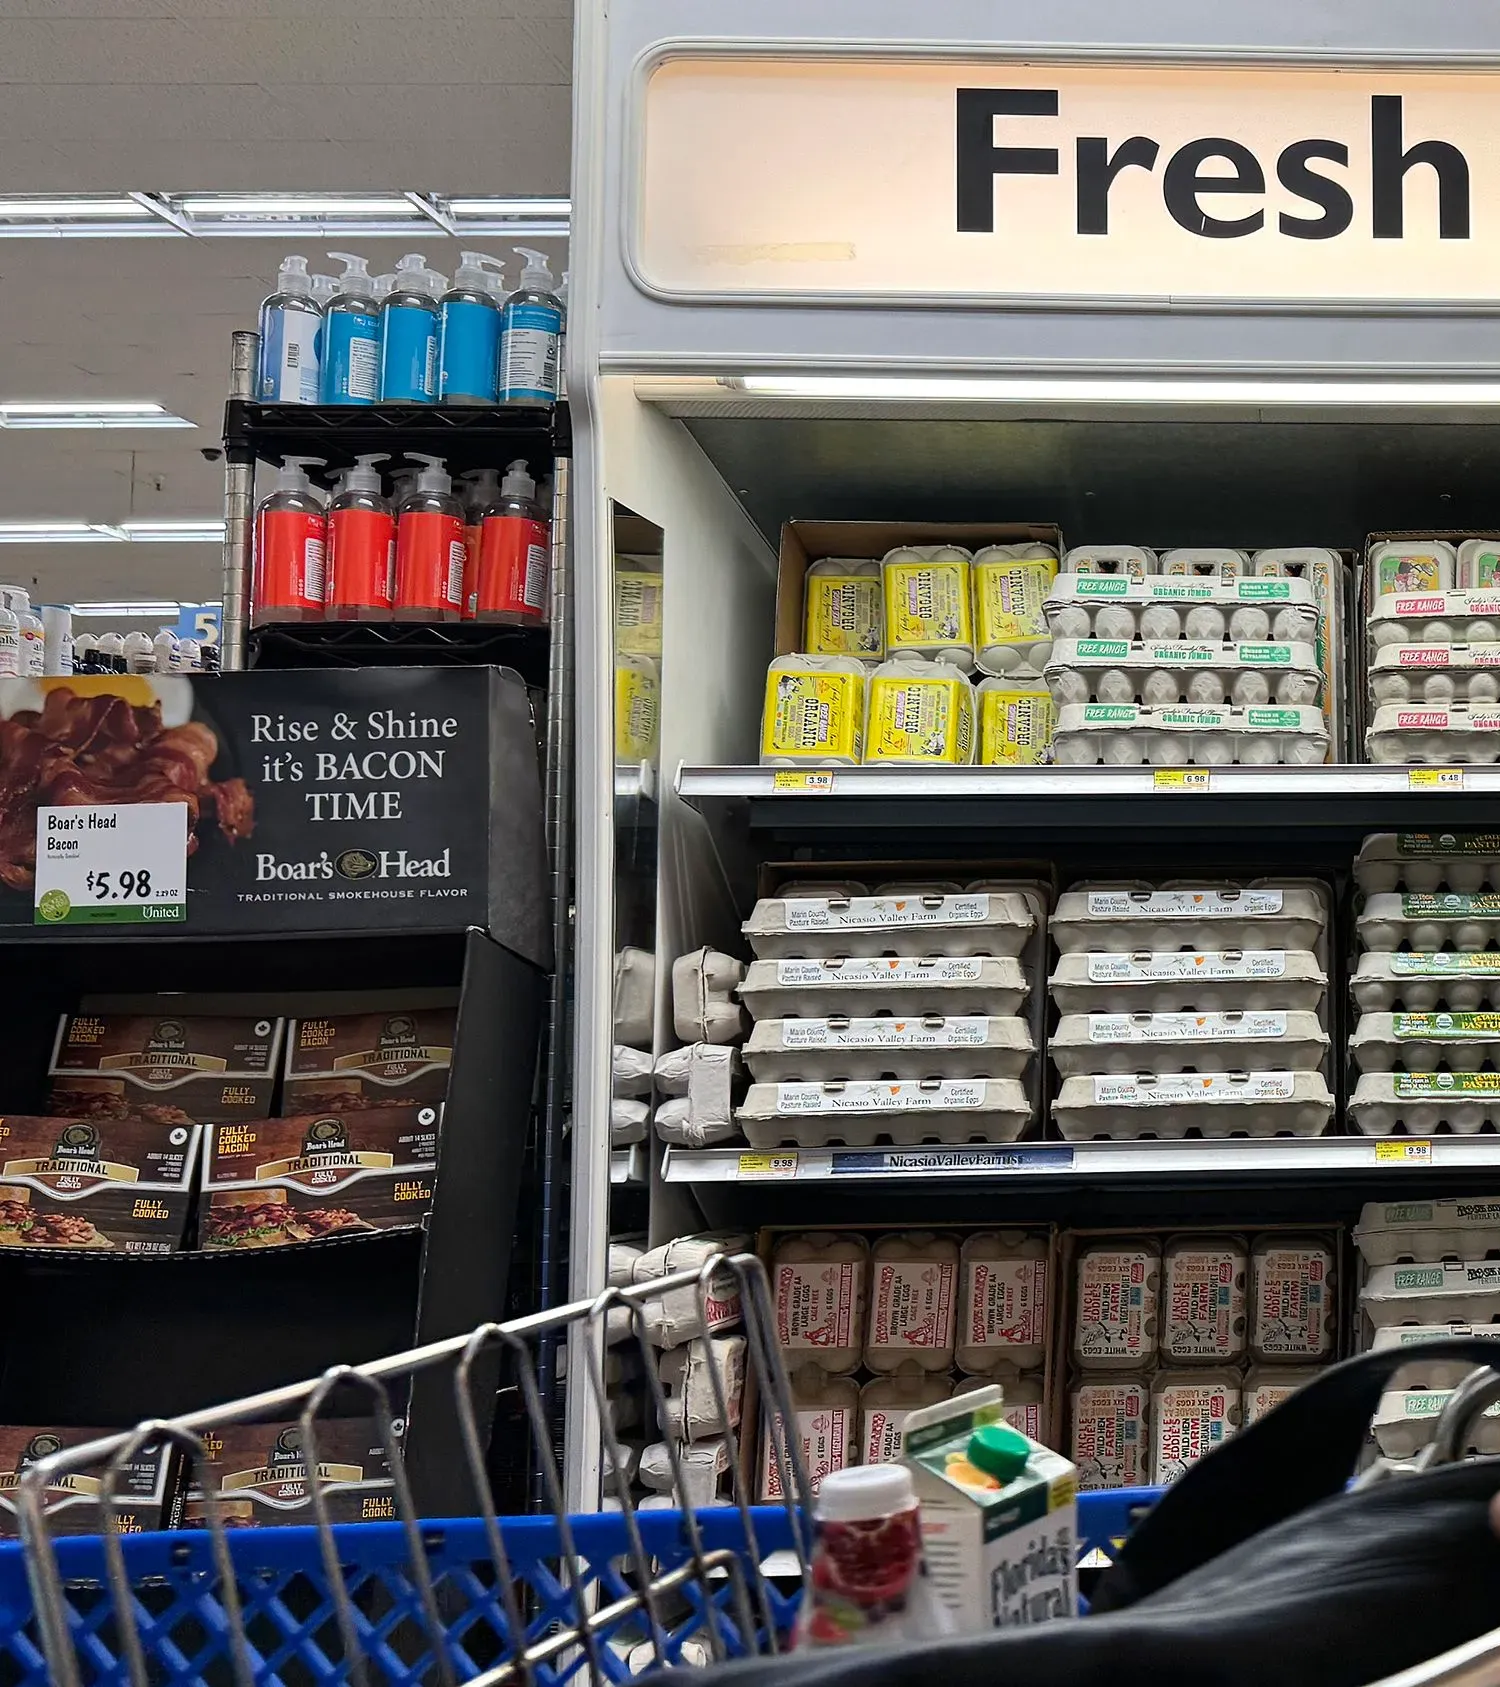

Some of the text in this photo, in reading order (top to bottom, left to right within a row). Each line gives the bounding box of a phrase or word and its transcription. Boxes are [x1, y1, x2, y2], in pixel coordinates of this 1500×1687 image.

[956, 88, 1471, 239] Fresh
[1078, 581, 1126, 592] FREE RANGE
[1153, 588, 1186, 597] ORGANIC
[1396, 600, 1443, 611] FREE RANGE
[194, 613, 219, 644] 5
[1078, 644, 1126, 654] FREE RANGE
[1155, 651, 1187, 659] ORGANIC
[905, 687, 921, 734] ORGANIC
[1086, 708, 1134, 718] FREE RANGE
[1017, 699, 1030, 746] ORGANIC
[1163, 715, 1195, 724] ORGANIC
[251, 711, 458, 744] Rise & Shine
[262, 750, 445, 782] it's BACON
[809, 776, 828, 784] 3.98
[305, 791, 402, 821] TIME
[48, 813, 117, 831] Boar's Head
[47, 836, 78, 851] Bacon
[255, 849, 450, 881] Boar's Head
[86, 870, 151, 901] $5.98
[237, 888, 468, 902] TRADITIONAL SMOKEHOUSE FLAVOR
[143, 906, 179, 919] United
[840, 913, 937, 924] Nicasio Valley Farm
[872, 972, 901, 980] Valley
[904, 971, 929, 979] Farm
[1140, 968, 1175, 976] Nicasio
[302, 1020, 330, 1030] FULLY
[301, 1028, 336, 1037] COOKED
[300, 1036, 329, 1047] BACON
[837, 1035, 935, 1044] Nicasio Valley Farm
[129, 1053, 198, 1067] TRADITIONAL
[832, 1099, 868, 1107] Nicasio
[871, 1098, 901, 1107] Valley
[220, 1125, 249, 1136] FULLY
[219, 1133, 256, 1145] COOKED
[218, 1143, 249, 1154] BACON
[1409, 1146, 1427, 1155] 9.98
[35, 1161, 108, 1175] TRADITIONAL
[287, 1154, 362, 1172] TRADITIONAL
[395, 1181, 423, 1191] FULLY
[394, 1189, 431, 1201] COOKED
[135, 1200, 163, 1209] FULLY
[132, 1209, 169, 1219] COOKED
[802, 1284, 810, 1302] EGGS
[1290, 1280, 1299, 1318] FARM
[1083, 1283, 1093, 1321] UNCLE
[1101, 1283, 1111, 1320] WILD HEN
[1110, 1283, 1120, 1321] FARM
[1199, 1283, 1209, 1321] FARM
[1104, 1417, 1115, 1458] FARM
[1190, 1418, 1200, 1459] FARM
[254, 1465, 330, 1482] TRADITIAL
[361, 1506, 395, 1518] COOKE
